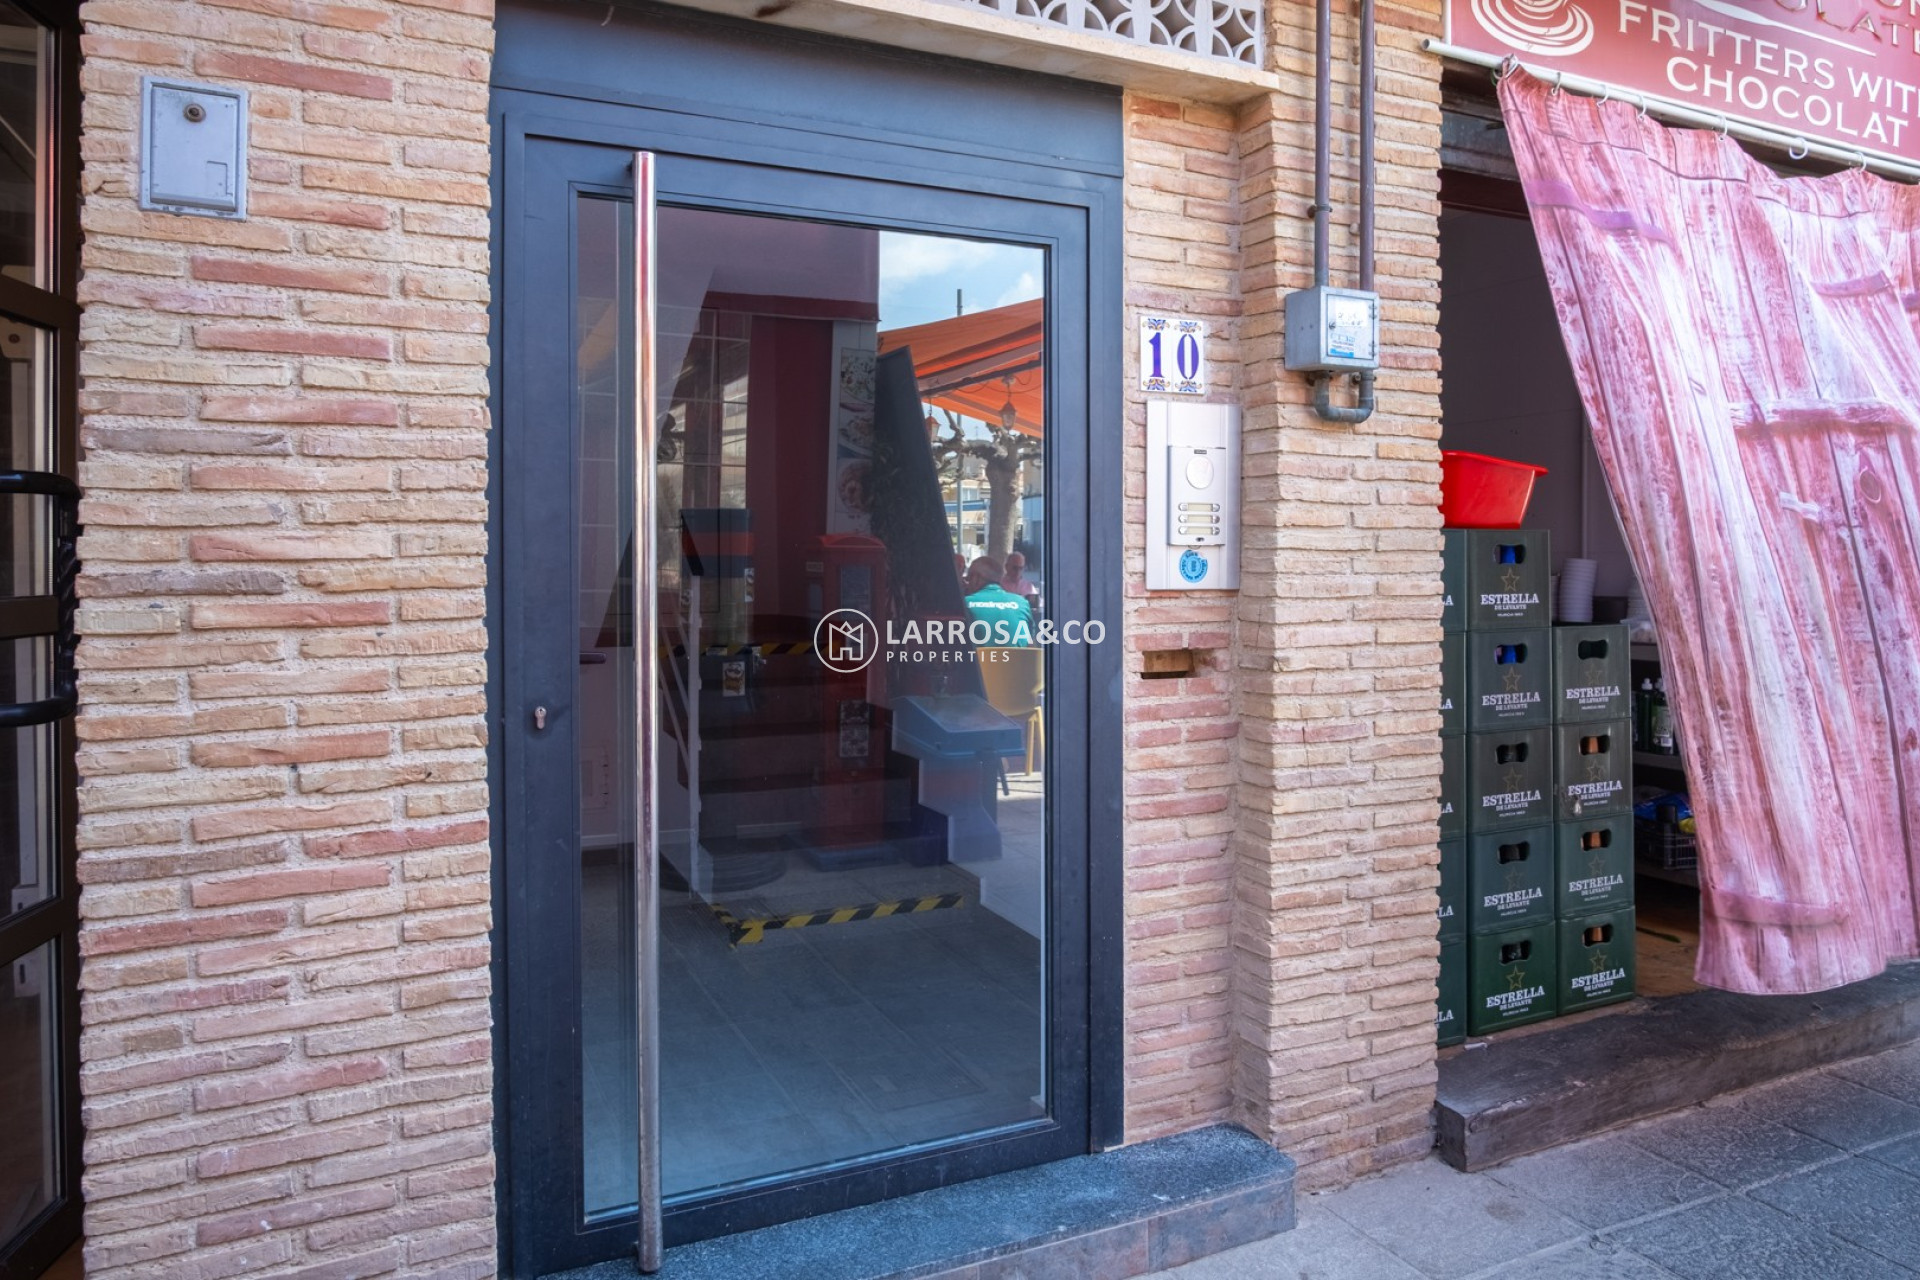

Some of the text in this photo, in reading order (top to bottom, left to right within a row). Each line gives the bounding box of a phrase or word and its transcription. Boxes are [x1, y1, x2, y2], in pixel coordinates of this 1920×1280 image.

[1619, 0, 1920, 118] FRITTERS WIT
[1666, 56, 1909, 148] CHOCOLAT
[1148, 332, 1200, 380] 10
[1480, 593, 1540, 606] ESTRELLA
[1482, 691, 1541, 706] ESTRELLA
[1566, 685, 1621, 699] ESTRELLA
[1482, 789, 1542, 807] ESTRELLA
[1568, 780, 1623, 796] ESTRELLA
[1568, 873, 1624, 892] ESTRELLA
[1483, 887, 1543, 908] ESTRELLA
[1571, 967, 1626, 989] ESTRELLA
[1486, 985, 1546, 1008] ESTRELLA
